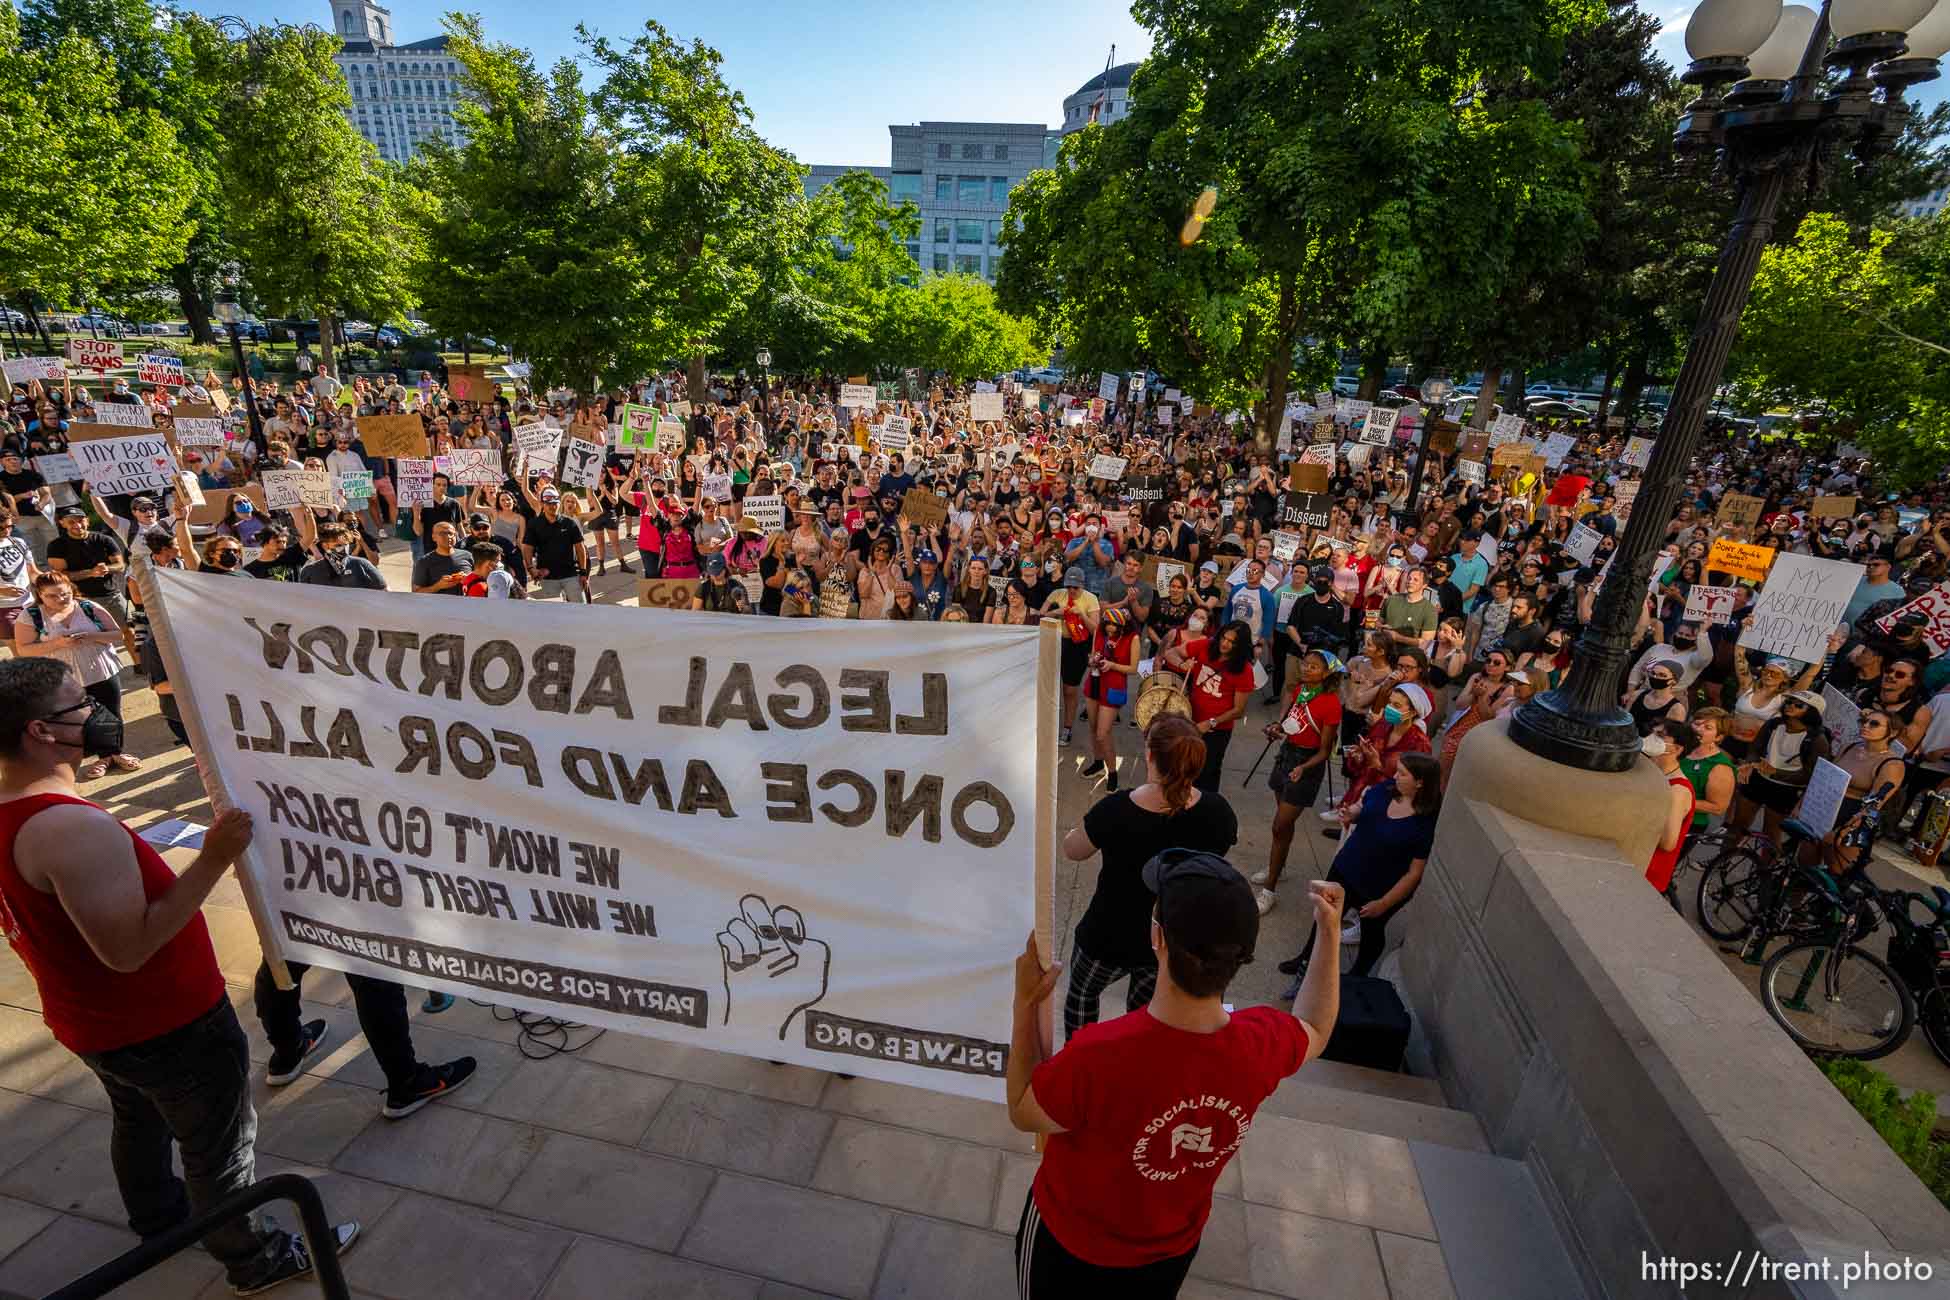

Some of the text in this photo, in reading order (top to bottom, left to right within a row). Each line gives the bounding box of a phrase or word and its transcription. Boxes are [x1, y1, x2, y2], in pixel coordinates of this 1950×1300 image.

[73, 338, 116, 354] STOP
[80, 353, 123, 368] BANS
[136, 354, 182, 368] A WOMAN
[137, 363, 181, 375] IS NOT AN
[1369, 426, 1386, 434] FIGHT
[83, 439, 172, 464] MY BODY
[117, 460, 146, 475] MY
[404, 460, 427, 469] TRUST
[265, 472, 324, 484] ABORTION
[573, 475, 586, 486] ME
[267, 490, 301, 504] HUMAN
[400, 490, 433, 501] CHOICE
[1129, 487, 1163, 500] Dissent
[743, 500, 780, 508] LEGALIZE
[1305, 495, 1313, 510] I
[743, 509, 780, 517] ABORTION
[1285, 506, 1328, 528] Dissent
[1583, 528, 1602, 541] COMING
[1786, 567, 1832, 594] MY
[1697, 586, 1720, 596] DARE
[1722, 589, 1737, 599] YOU
[1686, 608, 1729, 621] TO TAKE IT
[1758, 591, 1846, 625] ABORTION
[1752, 613, 1830, 650] AVED MY
[1144, 1094, 1232, 1135] SOCIALISM
[1228, 1105, 1242, 1118] &
[1132, 1136, 1151, 1161] FOR
[1135, 1162, 1179, 1181] PARTY
